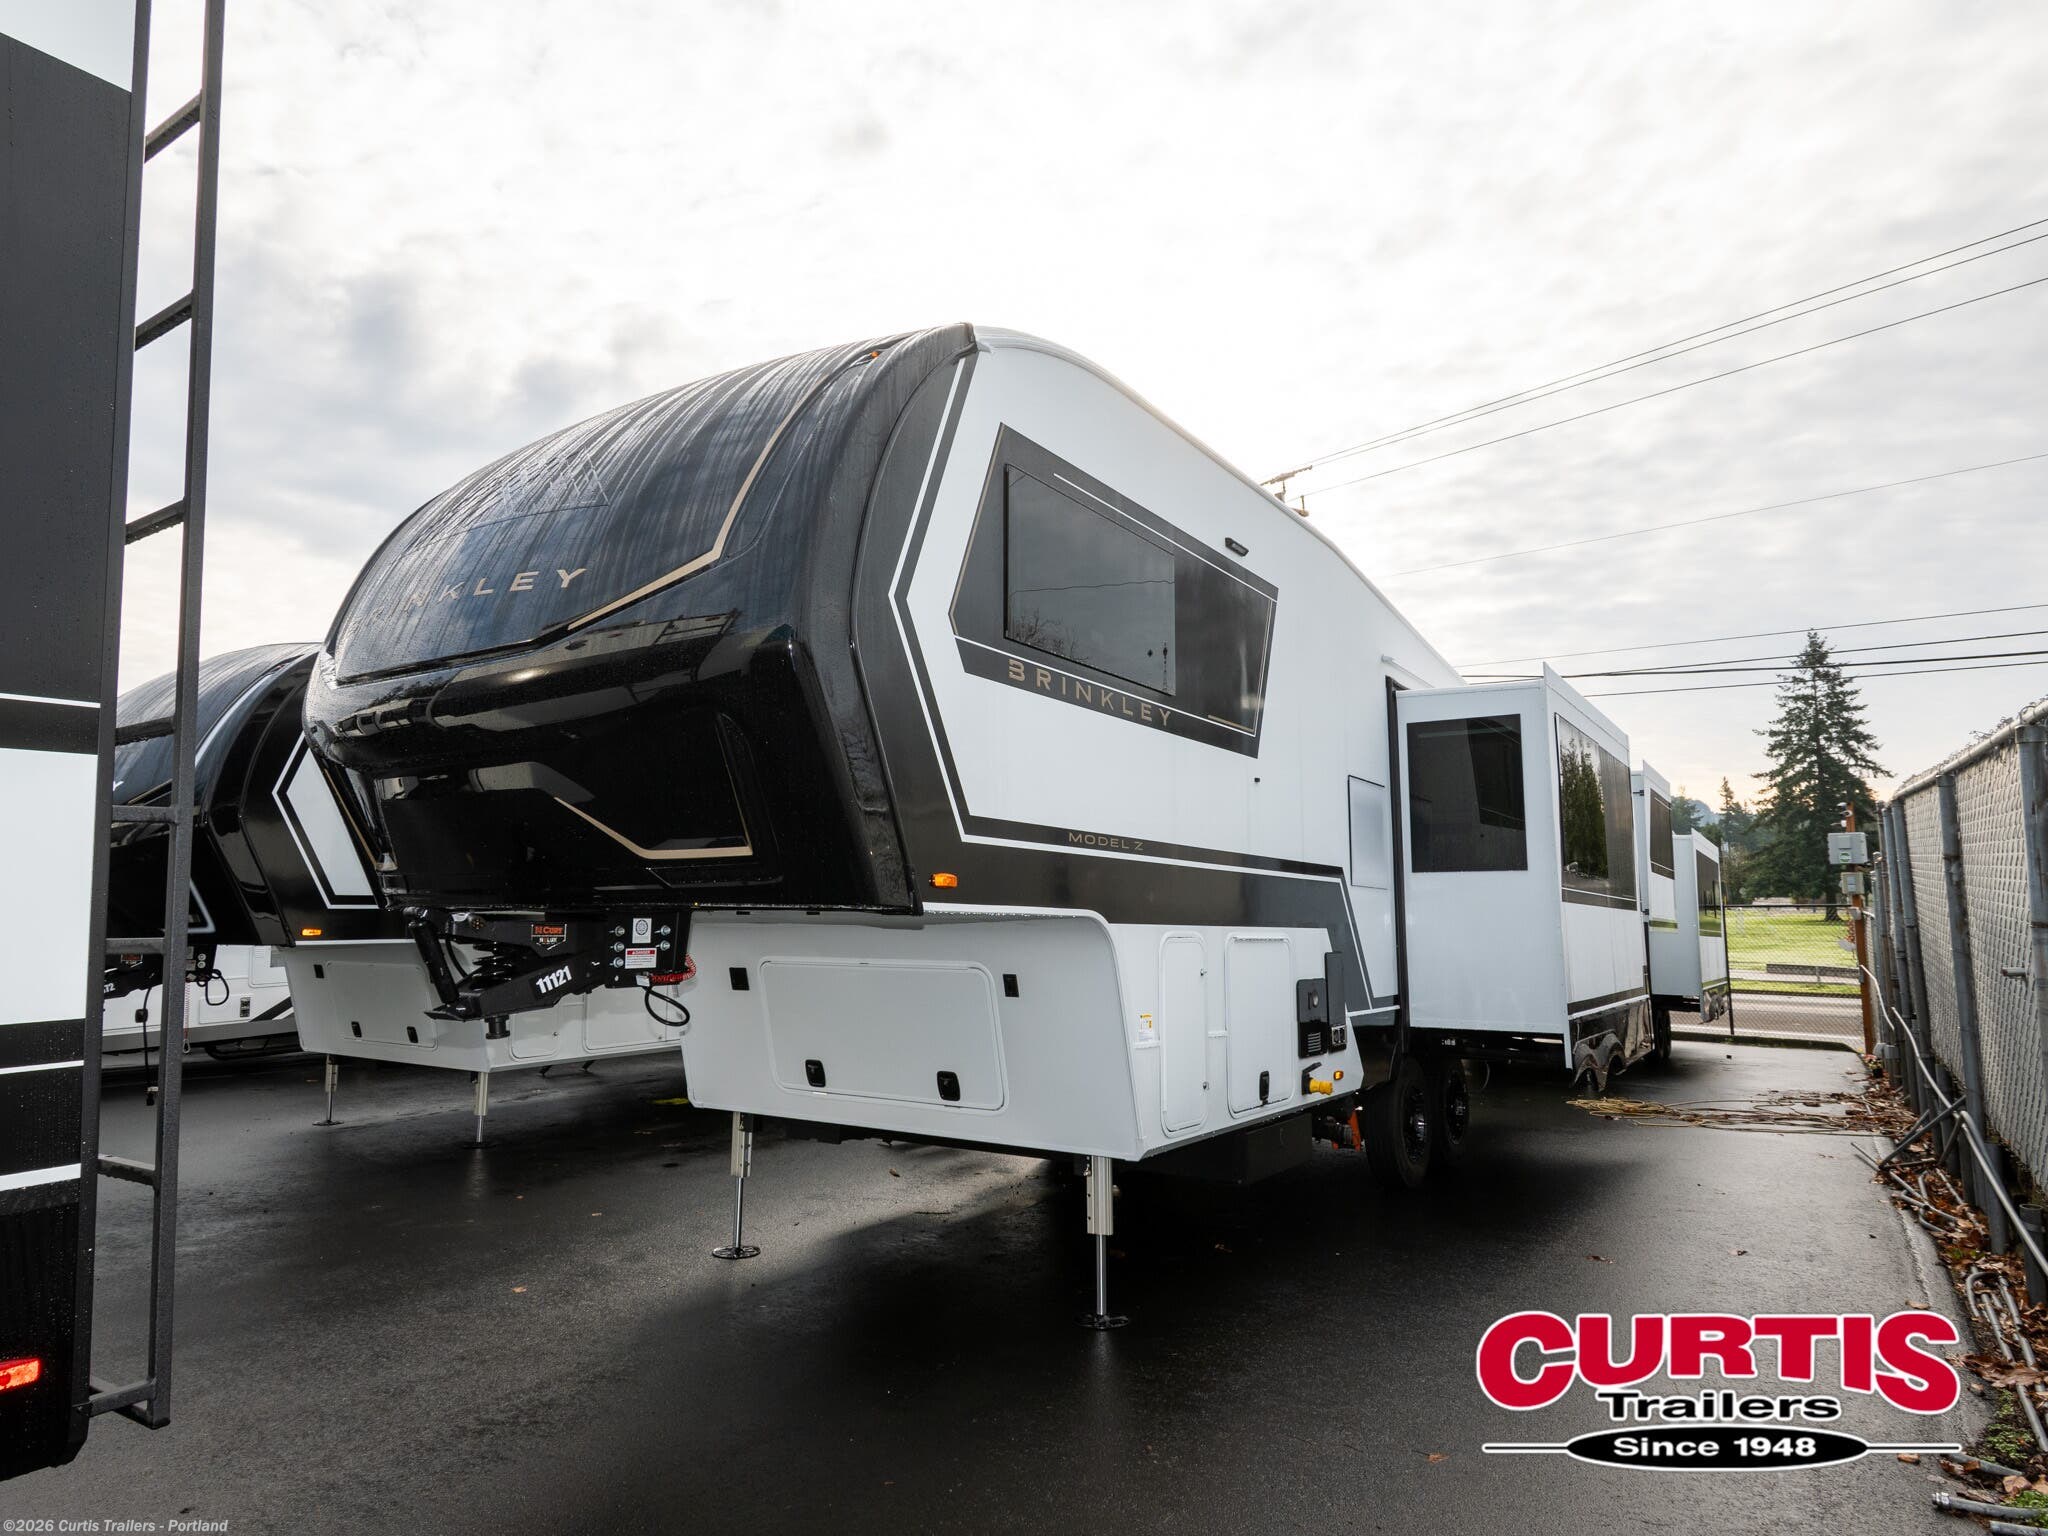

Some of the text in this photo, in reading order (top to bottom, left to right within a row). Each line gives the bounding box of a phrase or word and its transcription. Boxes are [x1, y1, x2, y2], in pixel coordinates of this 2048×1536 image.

[1008, 658, 1171, 726] BRINKLEY
[1068, 832, 1144, 851] MODEL Z
[536, 965, 572, 994] 11121
